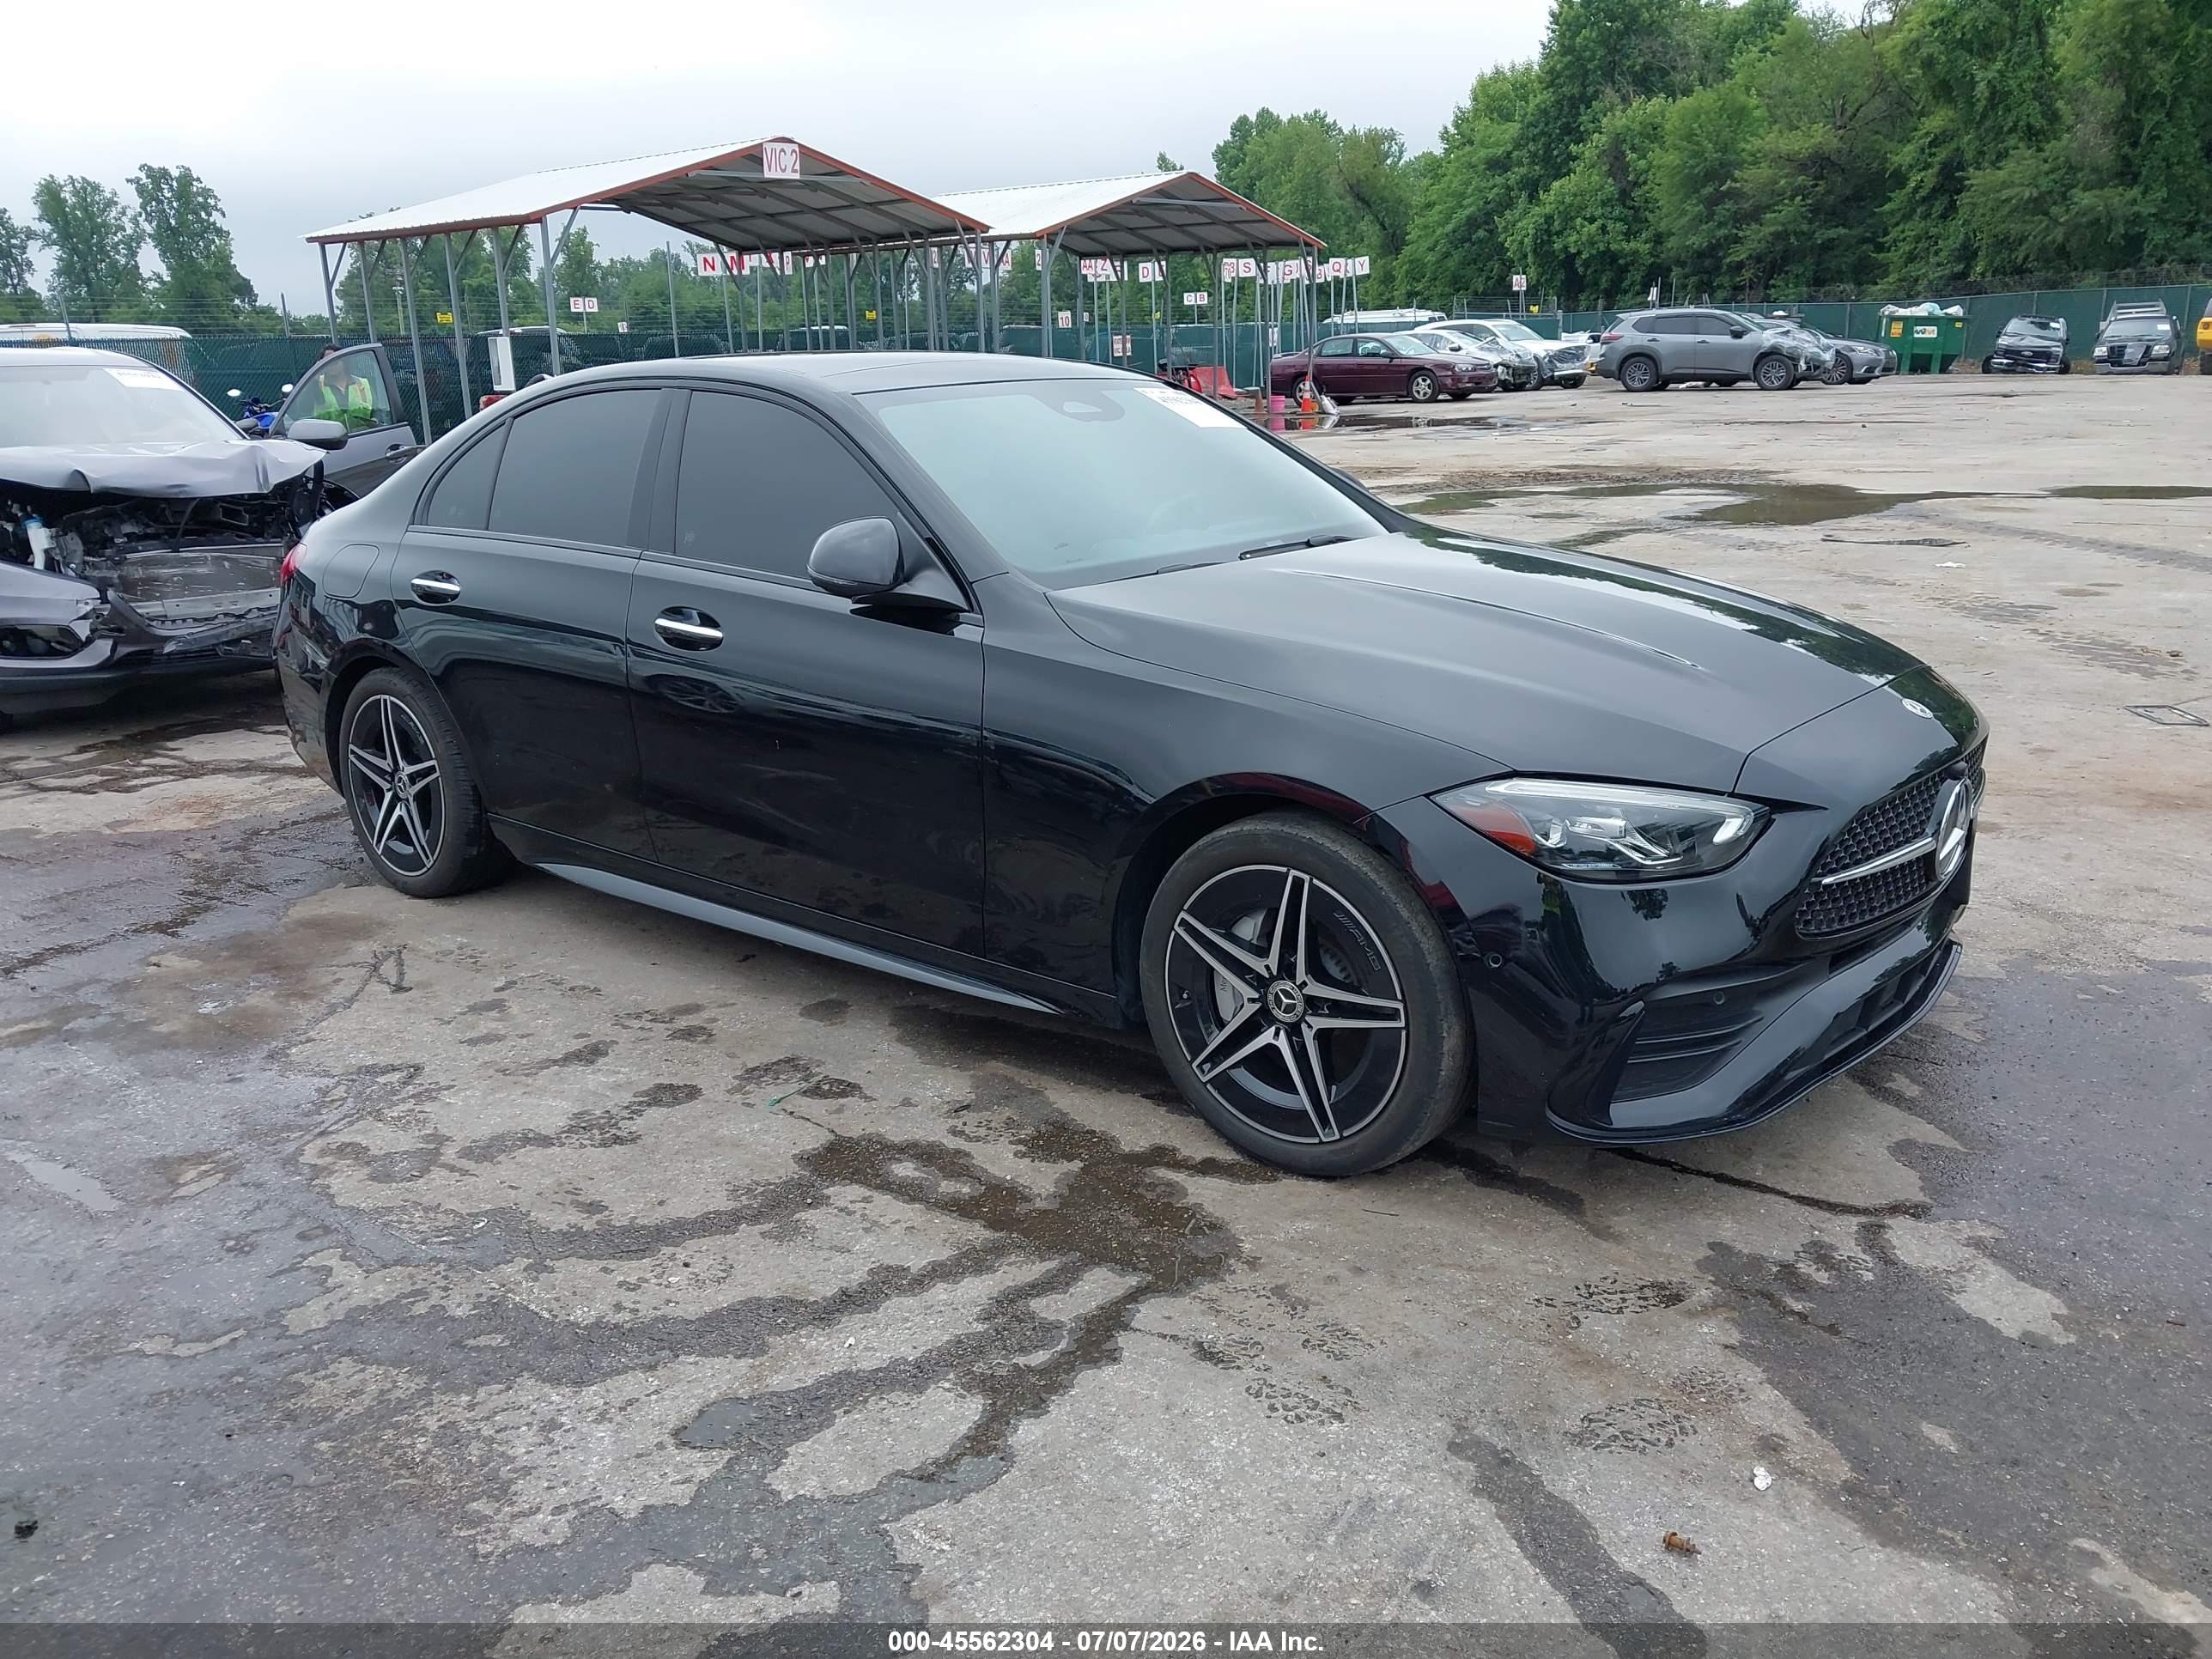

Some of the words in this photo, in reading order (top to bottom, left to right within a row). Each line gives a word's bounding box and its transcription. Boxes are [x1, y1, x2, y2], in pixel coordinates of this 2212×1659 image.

[764, 147, 787, 173] VIC
[790, 149, 799, 173] 2
[702, 256, 716, 271] N
[1082, 259, 1093, 270] AA
[1243, 261, 1252, 273] S
[1332, 261, 1342, 273] Q
[1358, 259, 1366, 271] Y
[1142, 266, 1150, 278] D
[1284, 264, 1293, 276] G
[573, 299, 580, 309] E
[587, 299, 595, 309] D
[1186, 294, 1194, 302] C
[1199, 294, 1206, 302] B
[1060, 315, 1070, 327] 10
